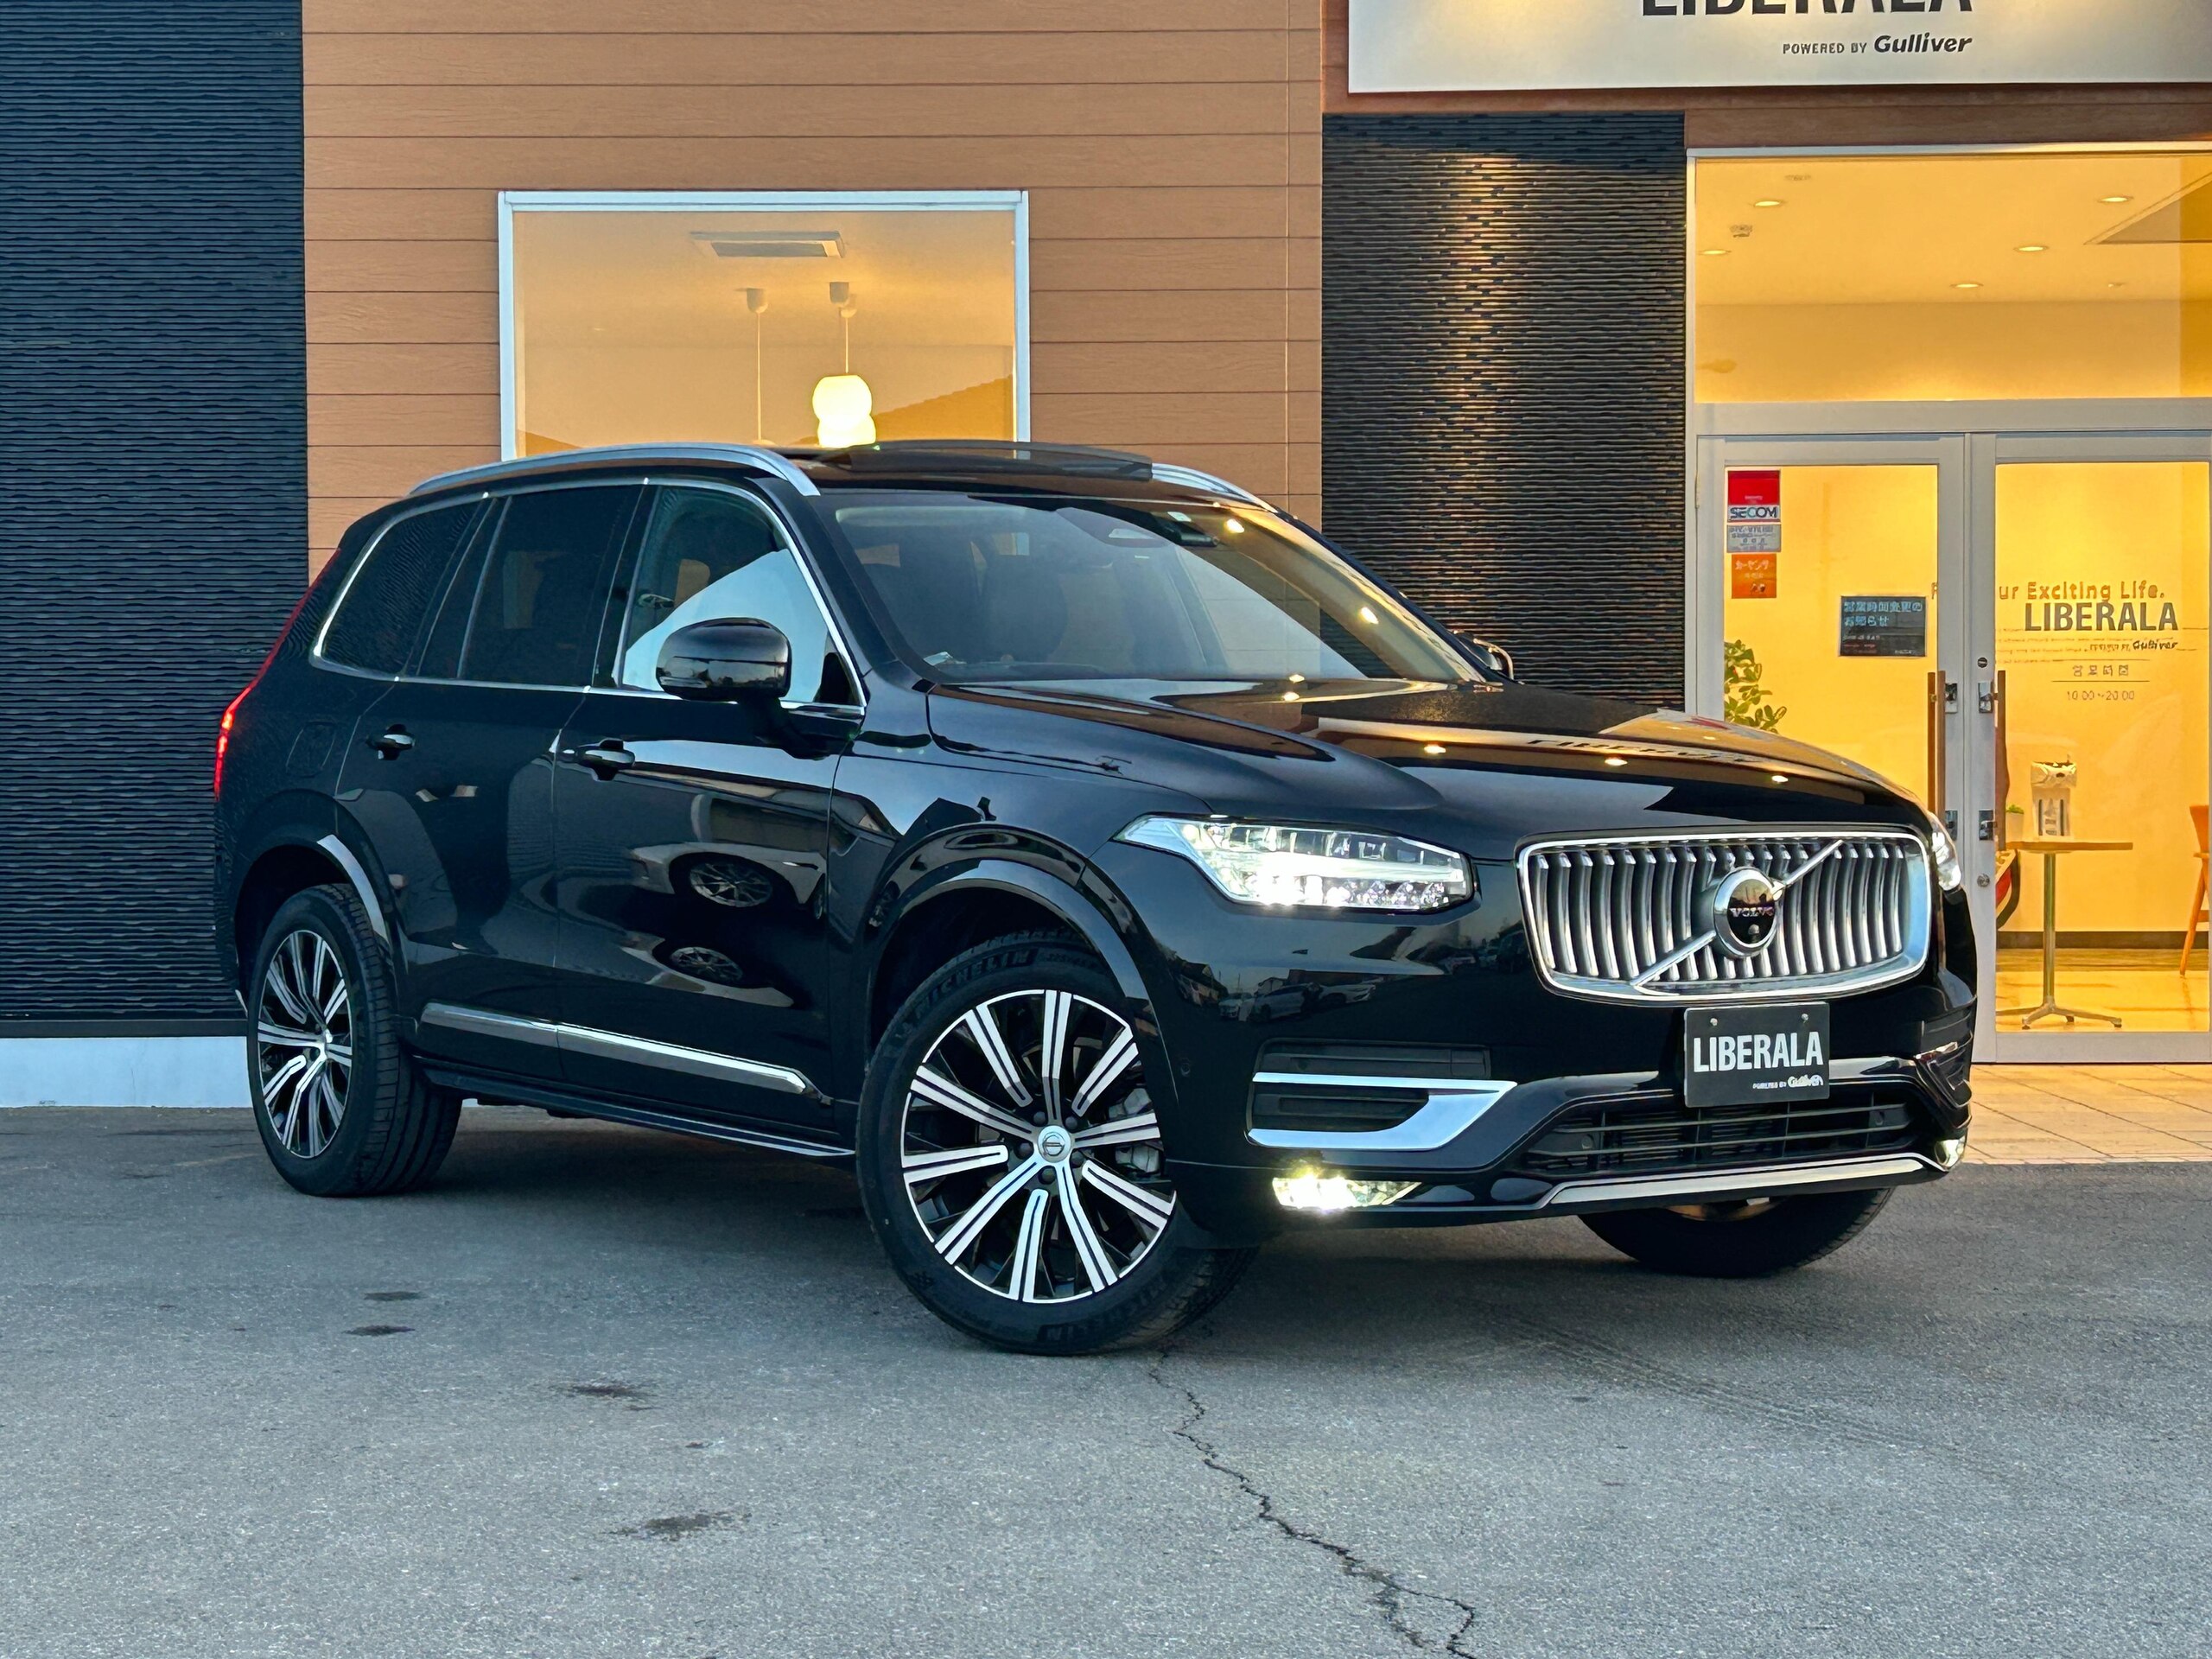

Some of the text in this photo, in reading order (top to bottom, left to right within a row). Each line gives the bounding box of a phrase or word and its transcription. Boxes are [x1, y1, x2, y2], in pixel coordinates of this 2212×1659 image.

[1783, 32, 1973, 55] POWERED BY Gulliver
[1729, 506, 1777, 518] SECOM
[1999, 580, 2164, 601] ur Exciting Life.
[2024, 601, 2178, 631] LIBERALA
[1694, 1031, 1824, 1073] LIBERALA
